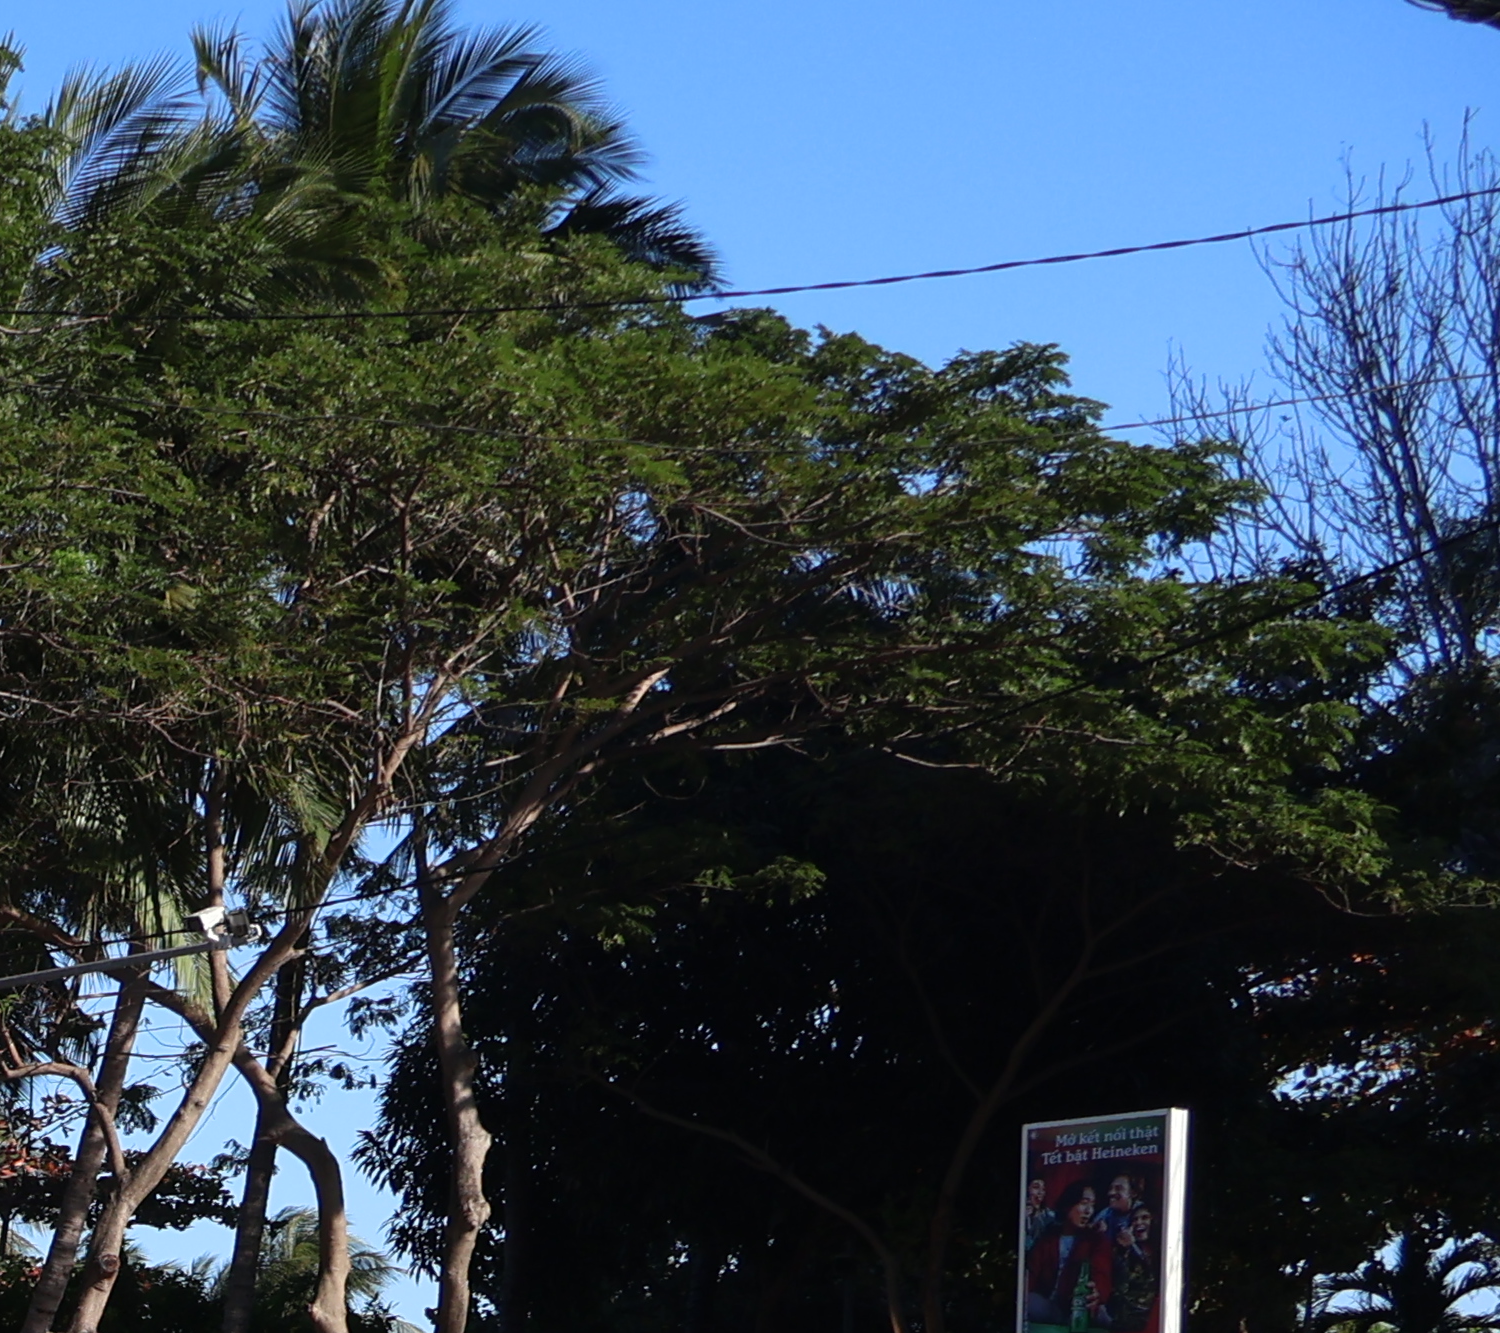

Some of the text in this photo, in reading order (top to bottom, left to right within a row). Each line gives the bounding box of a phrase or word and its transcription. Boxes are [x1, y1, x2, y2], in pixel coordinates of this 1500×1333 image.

[1055, 1125, 1159, 1147] Mở kết nối thật
[1041, 1143, 1159, 1165] Tết bật Heineken
